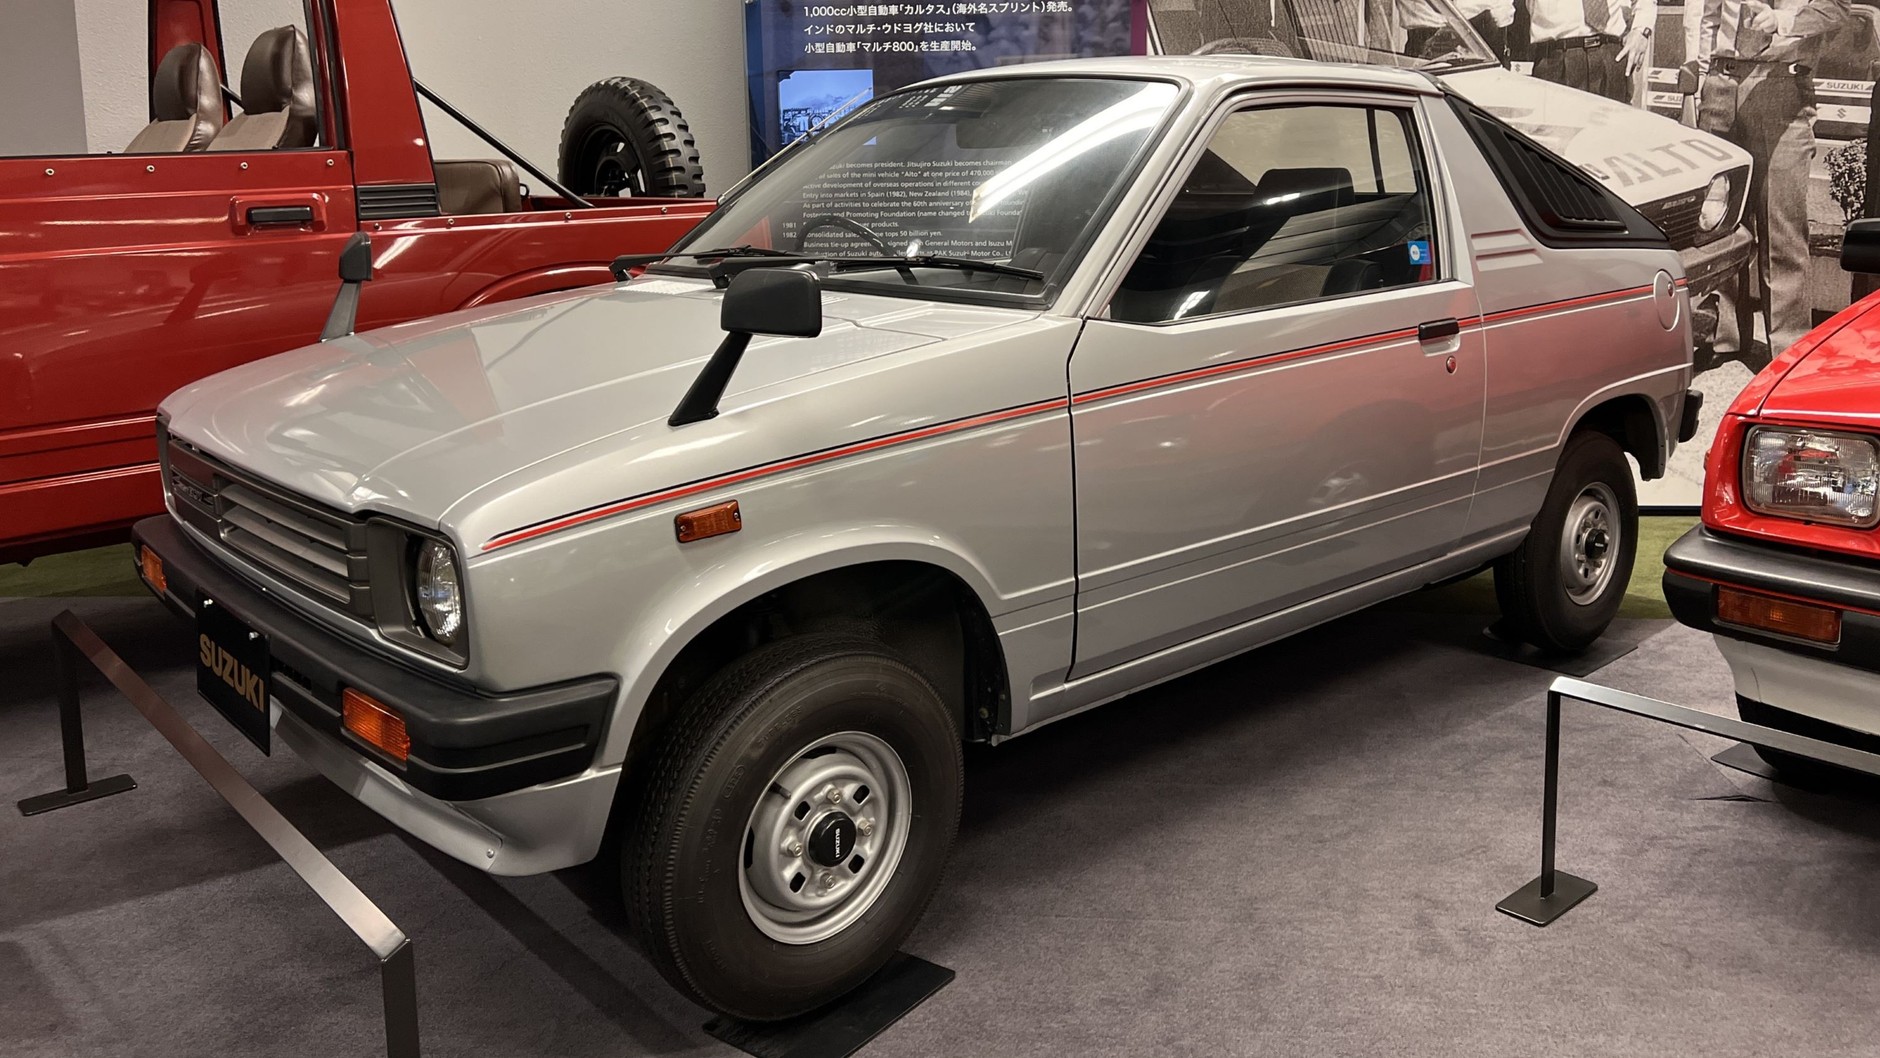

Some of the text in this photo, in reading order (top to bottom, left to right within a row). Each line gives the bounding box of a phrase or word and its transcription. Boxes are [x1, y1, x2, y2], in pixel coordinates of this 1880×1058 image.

[804, 22, 976, 35] インドのマルチ・ウドヨグ社において
[804, 40, 976, 53] 小型自動車「マルチ800」を生産開始。
[1826, 82, 1865, 91] SUZUKI
[846, 161, 873, 169] becomes
[906, 161, 931, 169] Jitsujiro
[1603, 139, 1733, 187] ALTO
[945, 170, 959, 178] price
[901, 180, 934, 188] operations
[803, 192, 819, 200] Entry
[867, 191, 885, 199] Spain
[871, 200, 900, 208] celebrate
[929, 200, 964, 208] anniversary
[846, 211, 879, 219] Promoting
[917, 210, 937, 218] (name
[200, 634, 264, 713] SUZUKI
